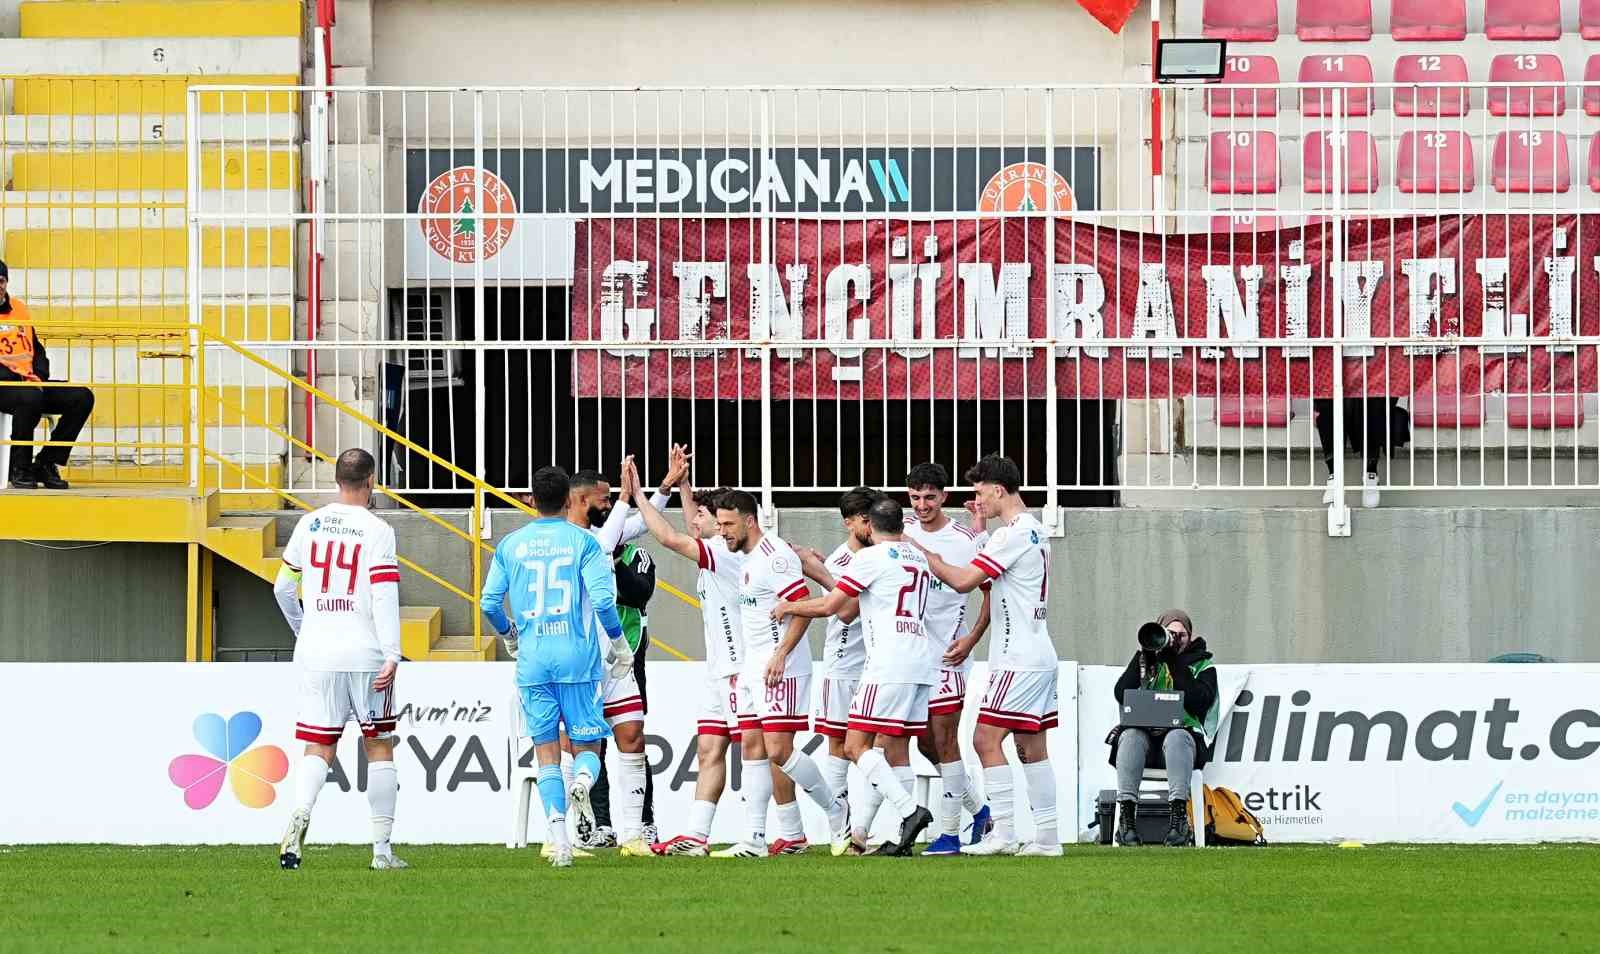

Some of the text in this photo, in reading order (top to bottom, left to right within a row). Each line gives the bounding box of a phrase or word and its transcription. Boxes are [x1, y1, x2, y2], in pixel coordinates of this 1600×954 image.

[1227, 57, 1250, 72] 10
[1322, 57, 1345, 72] 11
[1417, 56, 1441, 71] 12
[1514, 55, 1538, 70] 13
[152, 124, 163, 139] 5
[1518, 132, 1543, 146] 13
[1227, 132, 1250, 147] 10
[1423, 133, 1448, 148] 12
[579, 158, 873, 204] MEDICANA
[310, 540, 362, 595] 44
[521, 557, 574, 620] 35
[896, 565, 930, 620] 20
[1204, 690, 1600, 762] ilimat.c
[1233, 784, 1322, 812] etrik
[1504, 789, 1598, 807] en dayan
[1504, 806, 1599, 821] malzeme
